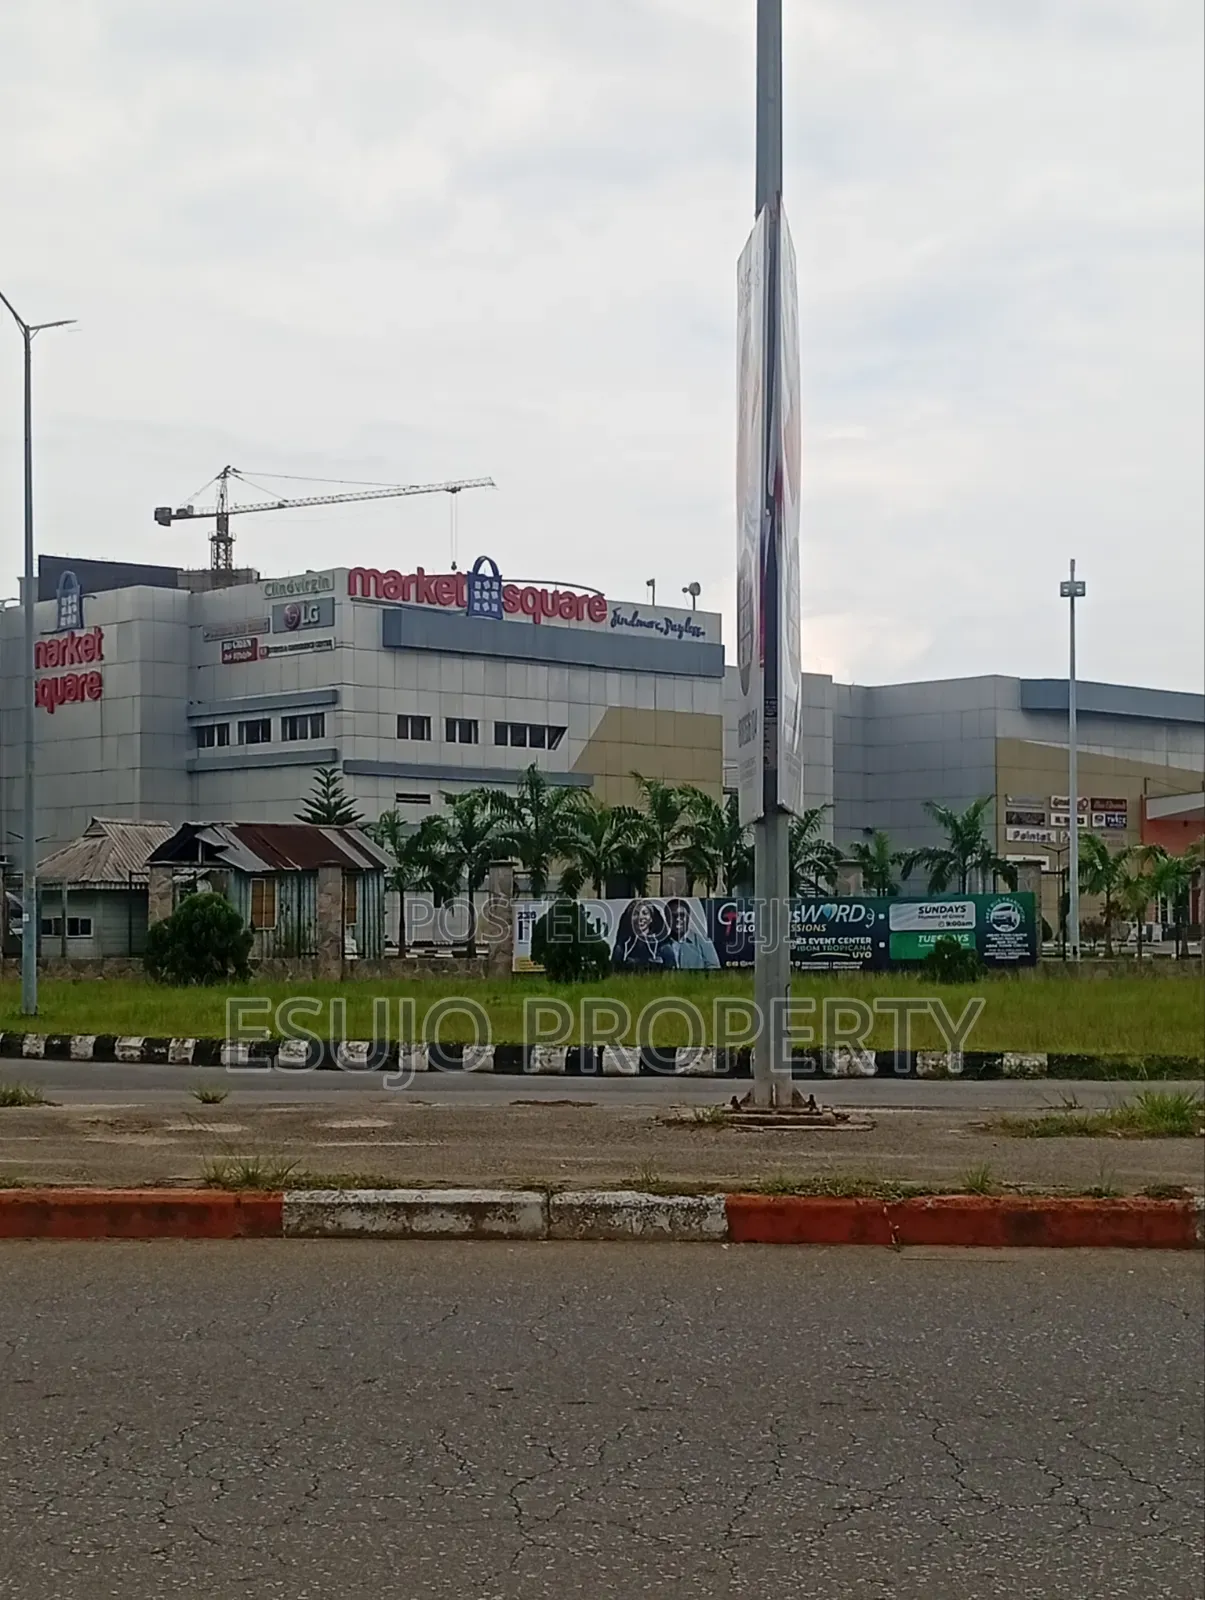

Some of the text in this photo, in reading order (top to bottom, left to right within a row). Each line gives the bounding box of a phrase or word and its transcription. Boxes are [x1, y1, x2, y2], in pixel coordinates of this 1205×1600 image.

[348, 567, 608, 624] market square
[302, 604, 320, 625] LG
[34, 671, 103, 714] quare
[918, 905, 967, 914] SUNDAYS
[808, 937, 836, 945] EVENT
[852, 951, 872, 959] UYO
